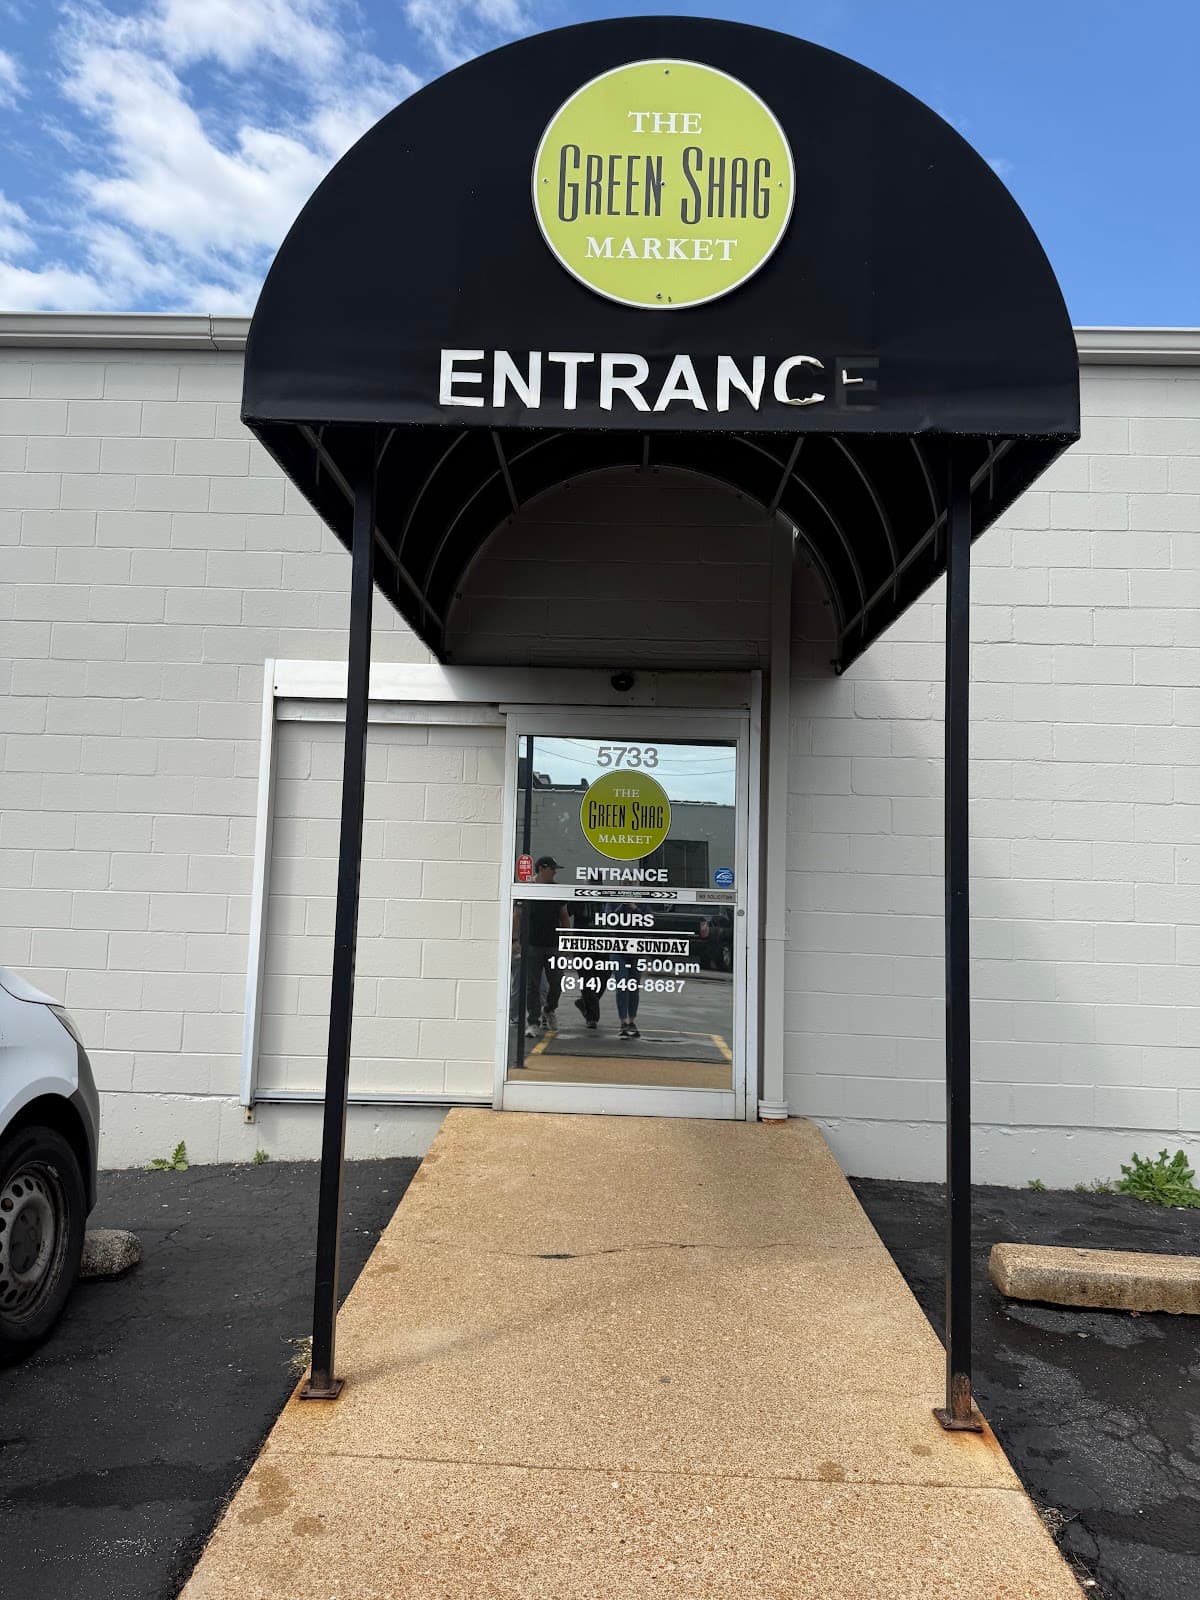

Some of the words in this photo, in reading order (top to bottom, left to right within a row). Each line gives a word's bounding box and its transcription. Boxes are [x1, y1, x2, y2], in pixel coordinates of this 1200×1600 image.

[628, 111, 702, 134] THE
[558, 144, 663, 222] GREEN
[680, 146, 771, 225] SHAG
[585, 236, 737, 261] MARKET
[597, 746, 659, 768] 5733
[613, 788, 640, 798] THE
[589, 800, 626, 830] GREEN
[632, 801, 664, 830] SHAG
[598, 834, 652, 845] MARKET
[575, 866, 669, 882] ENTRANCE
[594, 912, 655, 927] HOURS
[561, 938, 629, 951] THURSDAY
[636, 941, 688, 954] SUNDAY
[548, 956, 620, 971] 10:00am
[636, 959, 700, 975] 5:00pm
[560, 976, 602, 993] (314)
[606, 978, 686, 993] 646-8687
